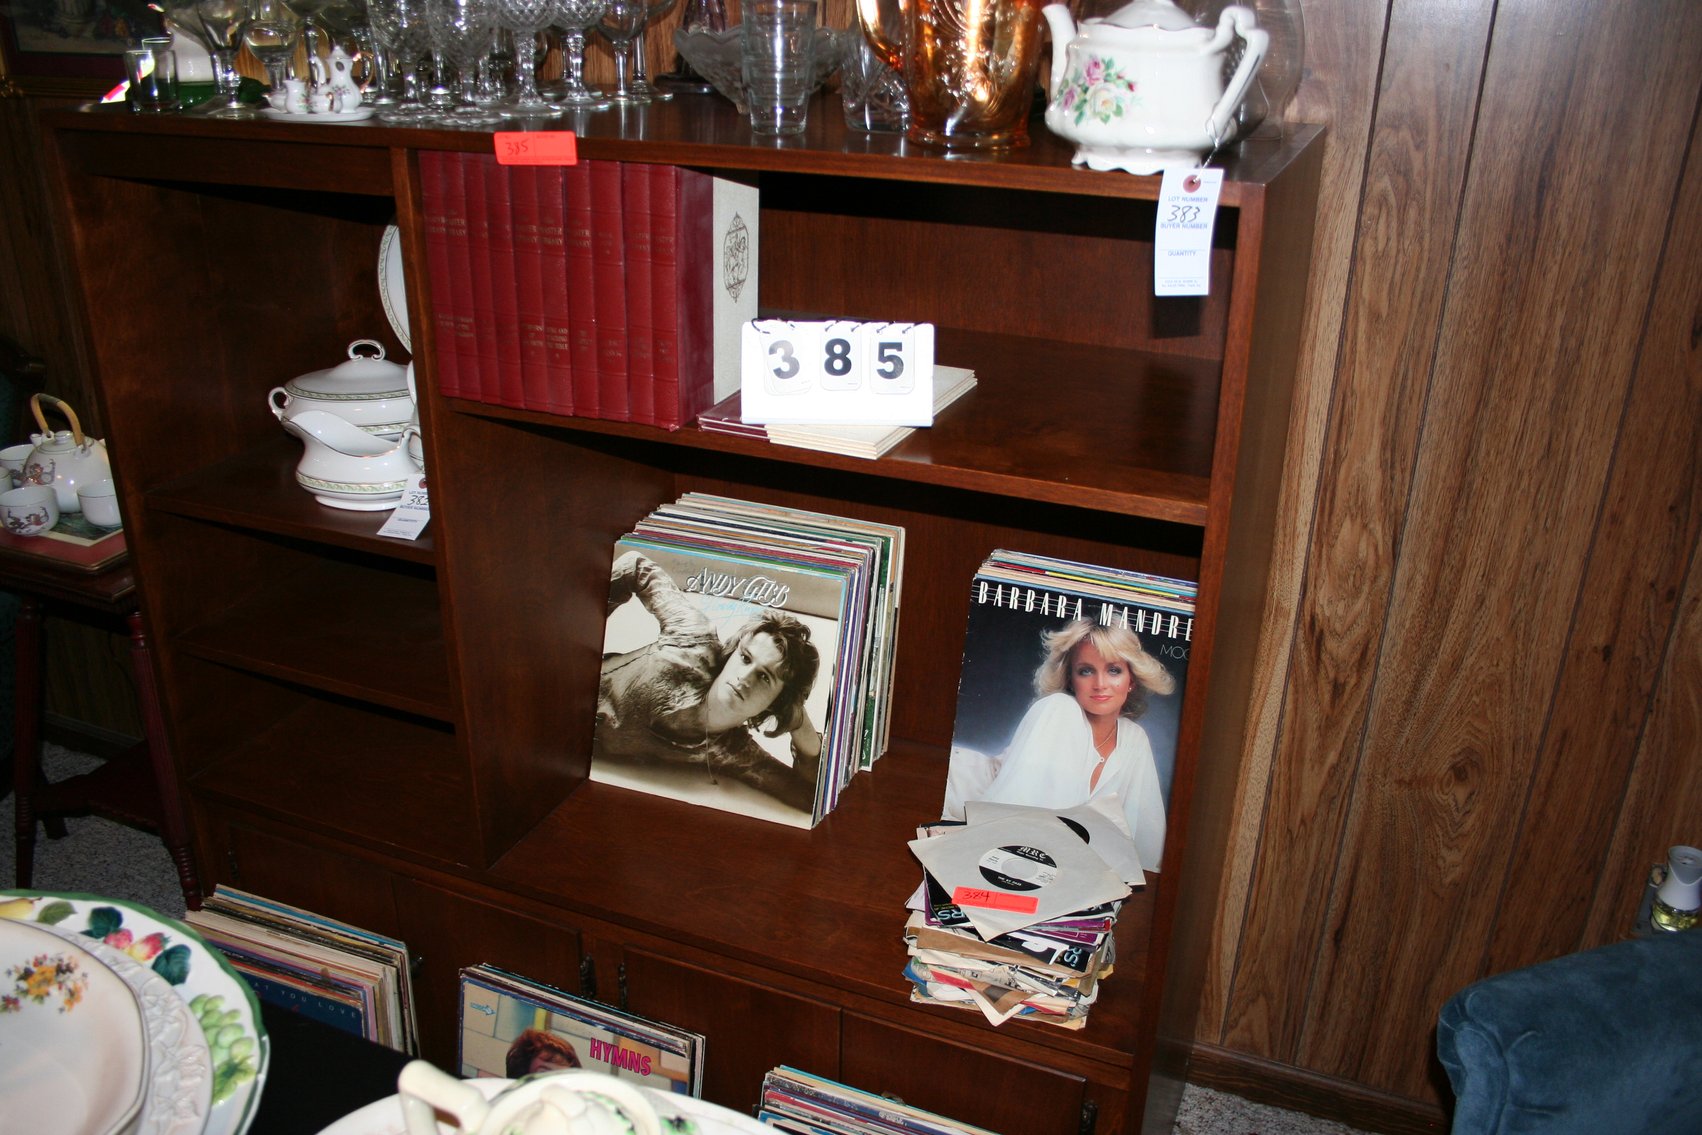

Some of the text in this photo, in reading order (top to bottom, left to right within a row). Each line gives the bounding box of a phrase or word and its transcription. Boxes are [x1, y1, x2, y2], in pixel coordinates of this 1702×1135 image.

[1167, 204, 1201, 223] 383
[1182, 222, 1208, 230] NUMBER
[767, 337, 905, 380] 385
[686, 567, 746, 597] ANDY
[743, 575, 791, 608] GIBB
[978, 581, 1083, 622] BARBARA
[961, 890, 991, 903] 384
[281, 990, 308, 1003] YOU
[318, 1002, 357, 1018] LOVE
[589, 1037, 652, 1077] HYMNS
